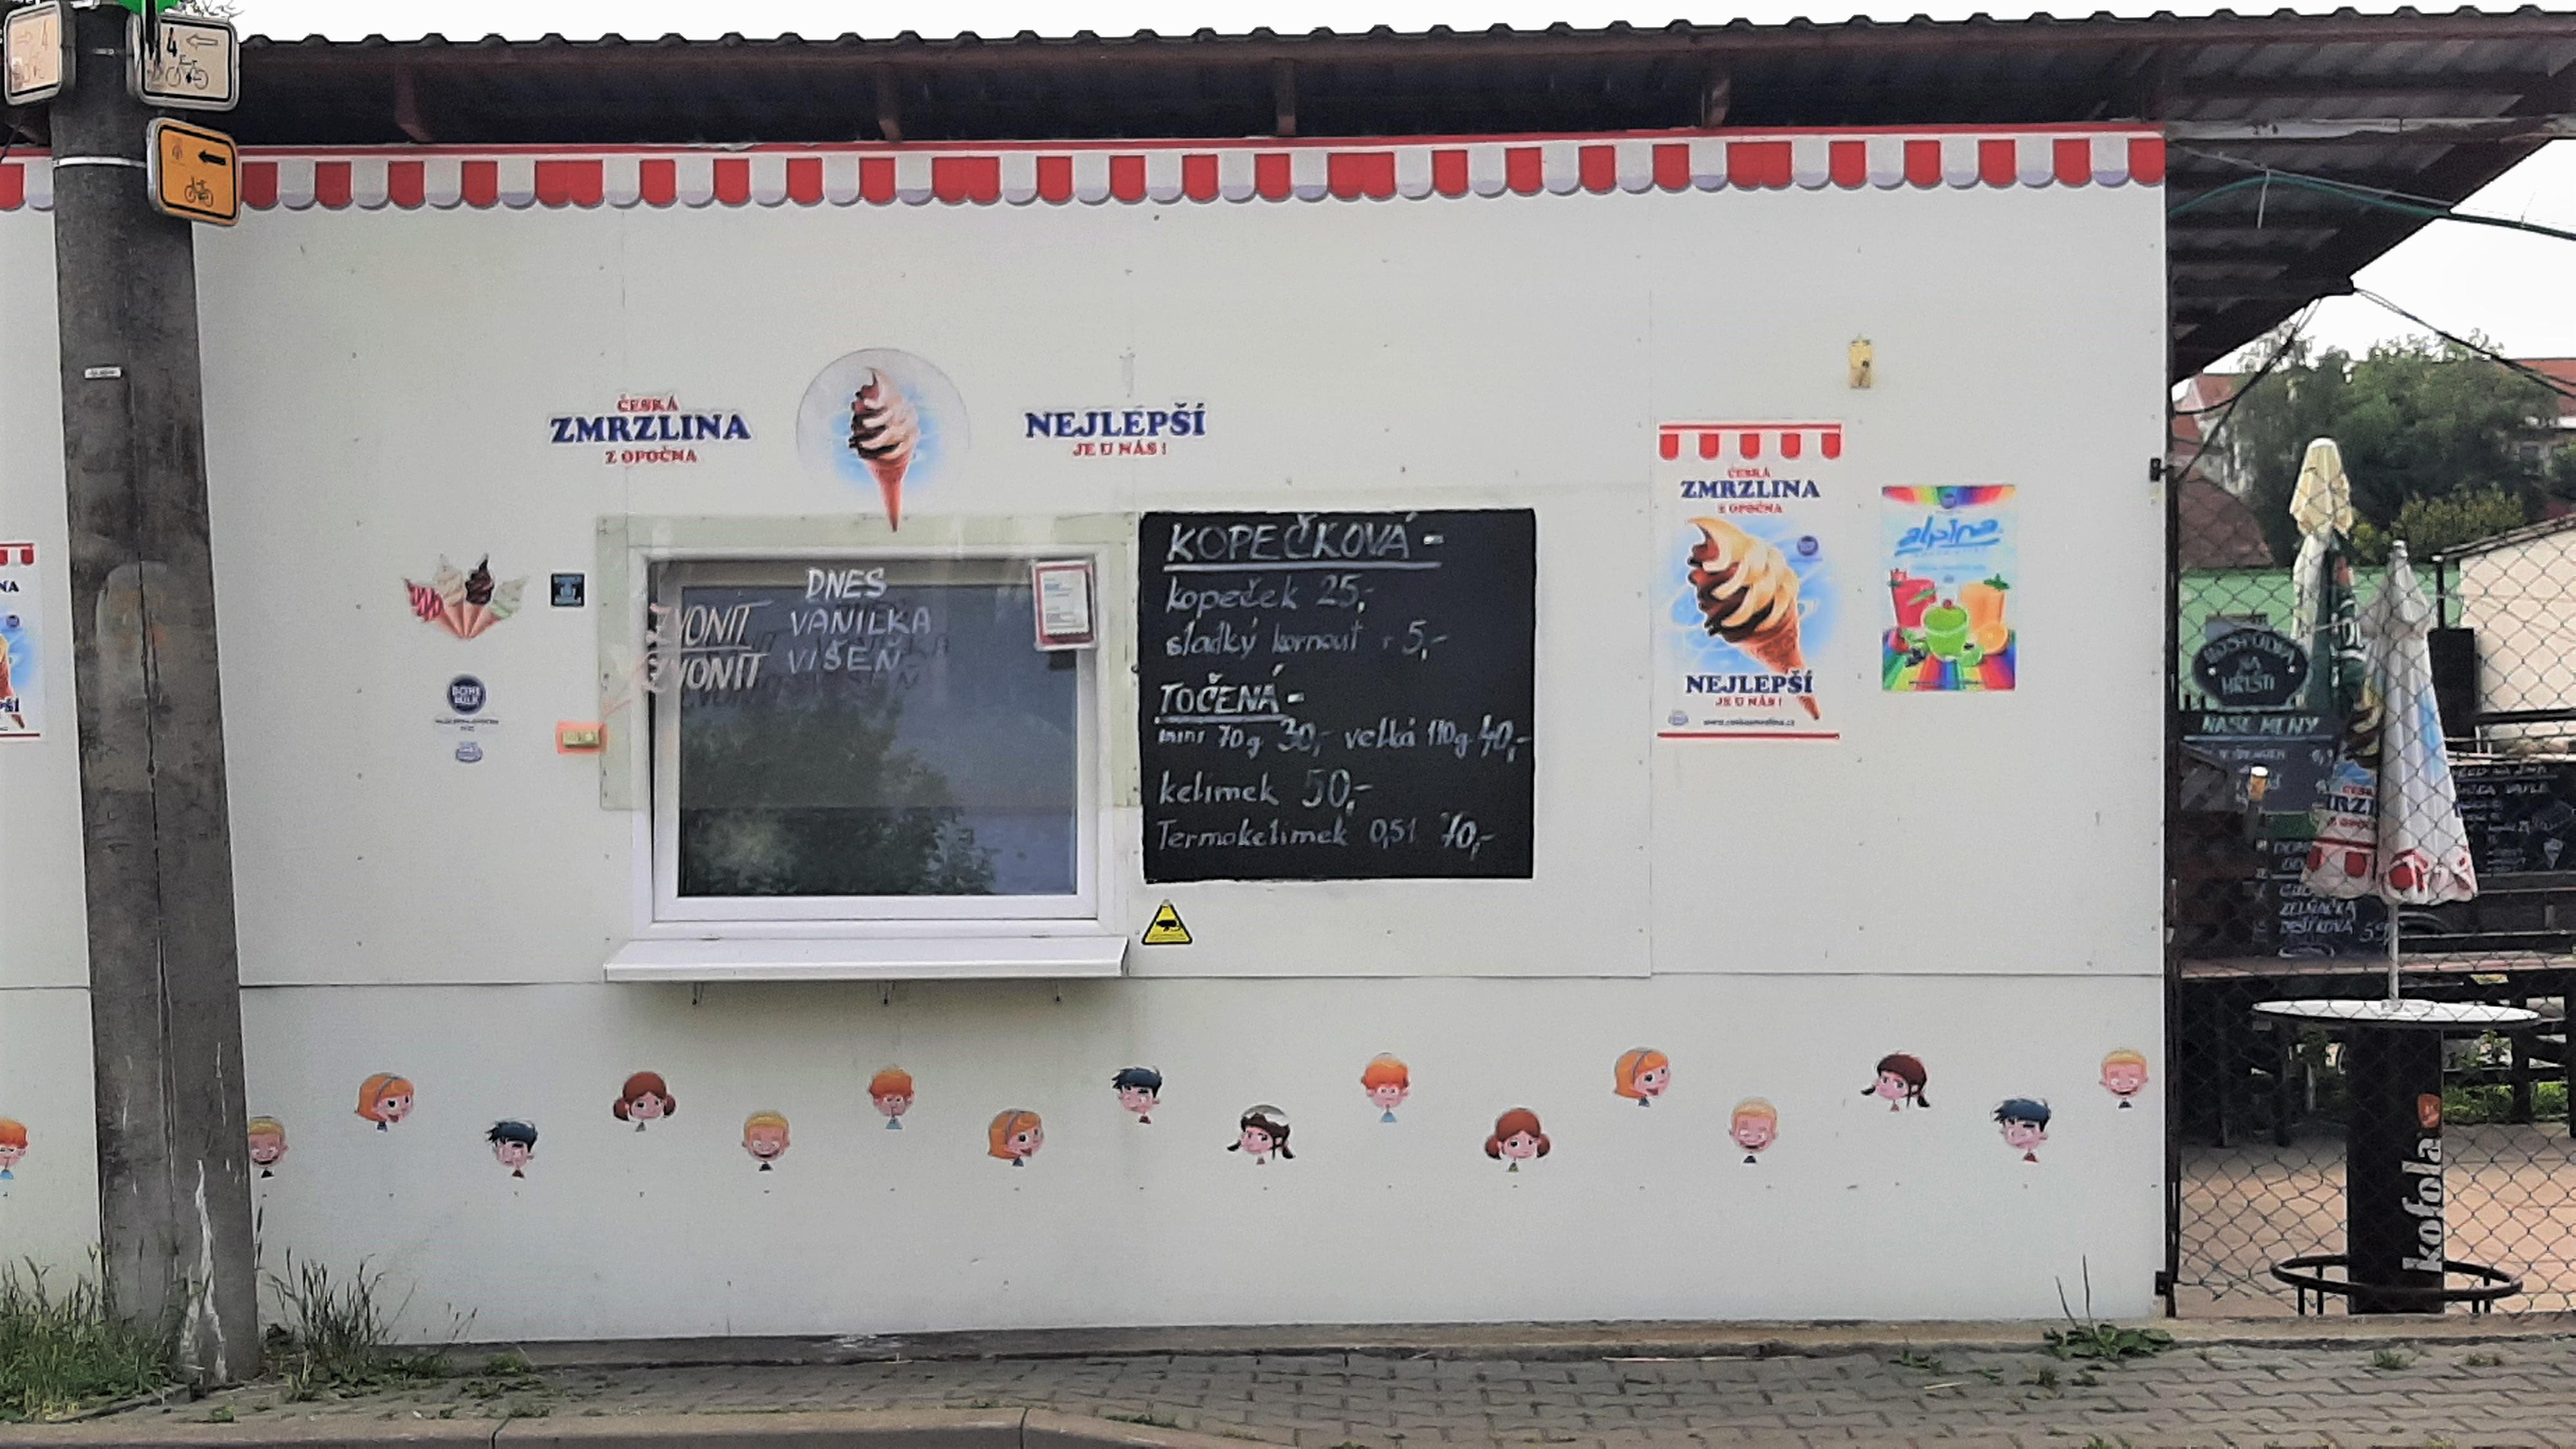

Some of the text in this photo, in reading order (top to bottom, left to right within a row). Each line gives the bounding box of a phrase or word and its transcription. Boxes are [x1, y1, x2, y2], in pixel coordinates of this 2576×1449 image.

[166, 27, 178, 58] 4
[617, 393, 678, 412] ČESKÁ
[551, 414, 752, 443] ZMRZLINA
[1025, 402, 1206, 437] NEJLEPŠÍ
[605, 446, 697, 464] Z OPOČNA
[1073, 443, 1095, 456] JE
[1101, 443, 1112, 455] U
[1680, 480, 1820, 498] ZMRZLINA
[1167, 511, 1417, 562] KOPEČKOVÁ
[805, 567, 887, 601] DNES
[1166, 576, 1300, 620] kopeček
[790, 607, 932, 637] VANILKA
[1166, 616, 1258, 659] sladký
[1685, 670, 1814, 694] NEJLEPŠÍ
[1716, 697, 1731, 706] JE
[1736, 697, 1743, 706] U
[1344, 717, 1416, 750] velká
[1479, 714, 1533, 762] 40,-
[1301, 769, 1373, 814] 50,-
[2401, 1137, 2443, 1274] kofola
